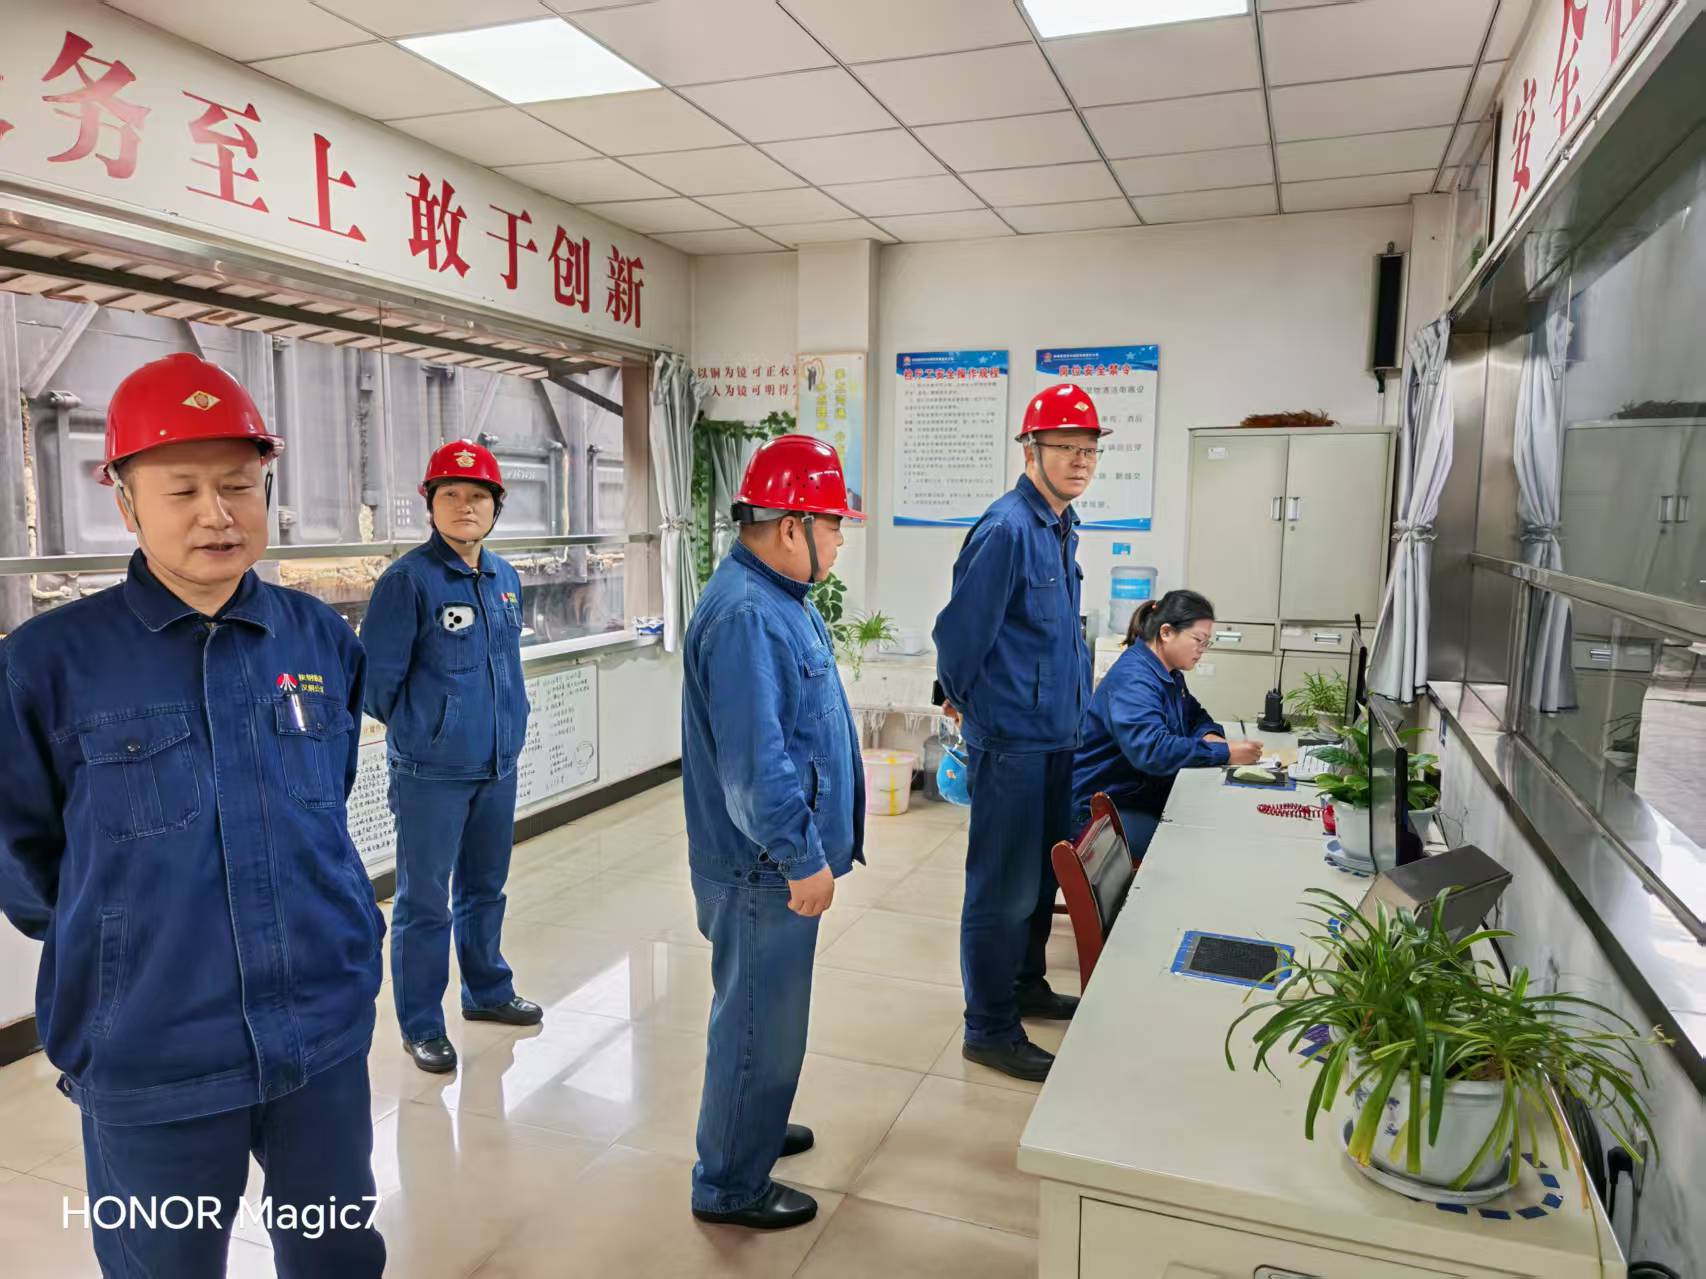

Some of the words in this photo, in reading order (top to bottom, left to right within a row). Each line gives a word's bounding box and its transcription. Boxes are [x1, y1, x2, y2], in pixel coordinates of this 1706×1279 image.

[0, 31, 366, 242] 务至上
[404, 172, 645, 329] 敢于创新
